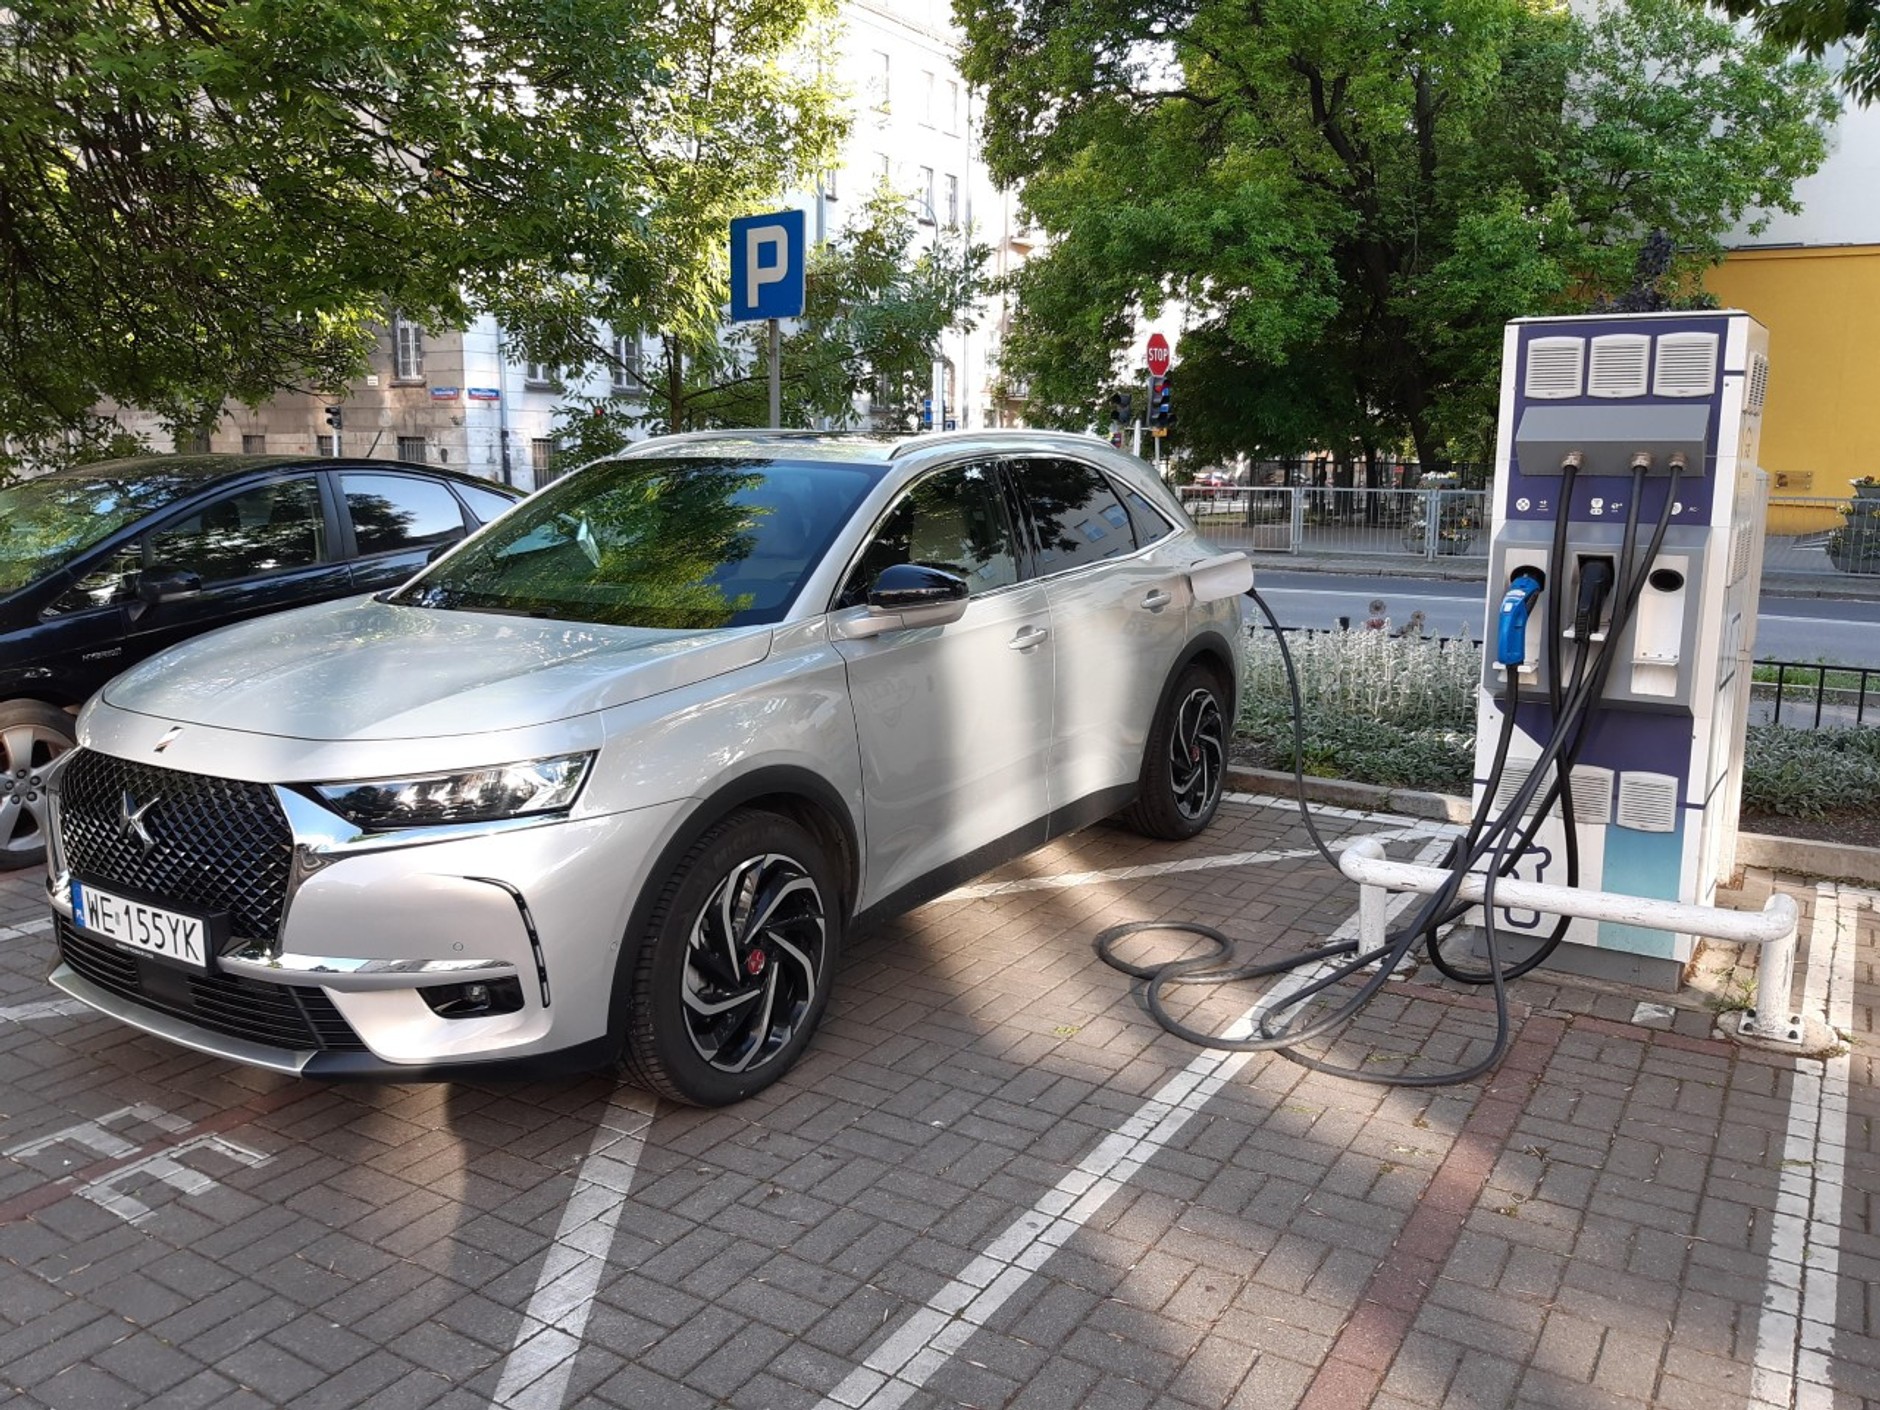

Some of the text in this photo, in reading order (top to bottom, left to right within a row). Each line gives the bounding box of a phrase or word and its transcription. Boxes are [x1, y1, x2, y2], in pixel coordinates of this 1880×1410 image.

[746, 224, 789, 309] P
[1148, 347, 1169, 362] STOP
[86, 890, 200, 961] WE 155YK
